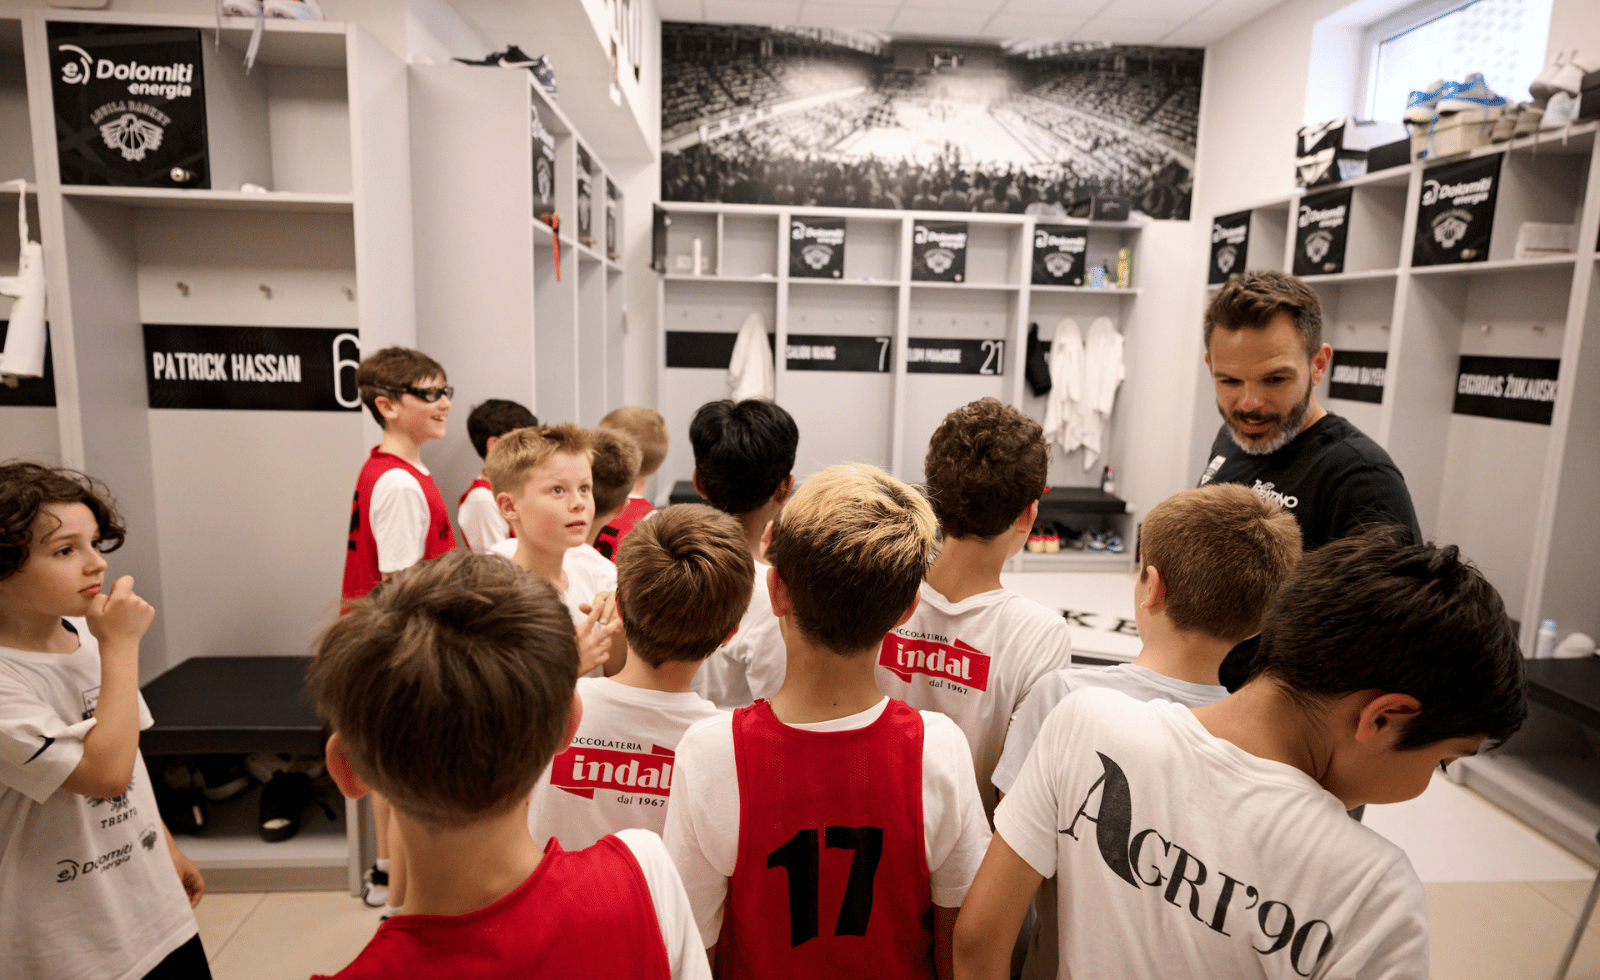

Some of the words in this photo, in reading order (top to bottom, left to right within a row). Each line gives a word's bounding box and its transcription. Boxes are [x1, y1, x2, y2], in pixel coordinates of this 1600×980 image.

[96, 59, 193, 83] Dolomiti
[127, 83, 192, 100] energia
[152, 352, 228, 381] PATRICK
[231, 353, 301, 383] HASSAN
[875, 337, 889, 372] 7
[980, 340, 1004, 374] 21
[332, 333, 361, 408] 6
[895, 628, 948, 643] CCOLATERIA
[896, 643, 973, 680] indal
[929, 679, 943, 688] dal
[947, 682, 968, 695] 1967
[572, 736, 642, 751] OCCOLATERIA
[572, 754, 672, 790] indal
[617, 794, 633, 805] dal
[638, 797, 666, 807] 1967
[100, 806, 138, 829] TRENTO
[82, 842, 133, 874] Domiti
[767, 825, 884, 949] 17
